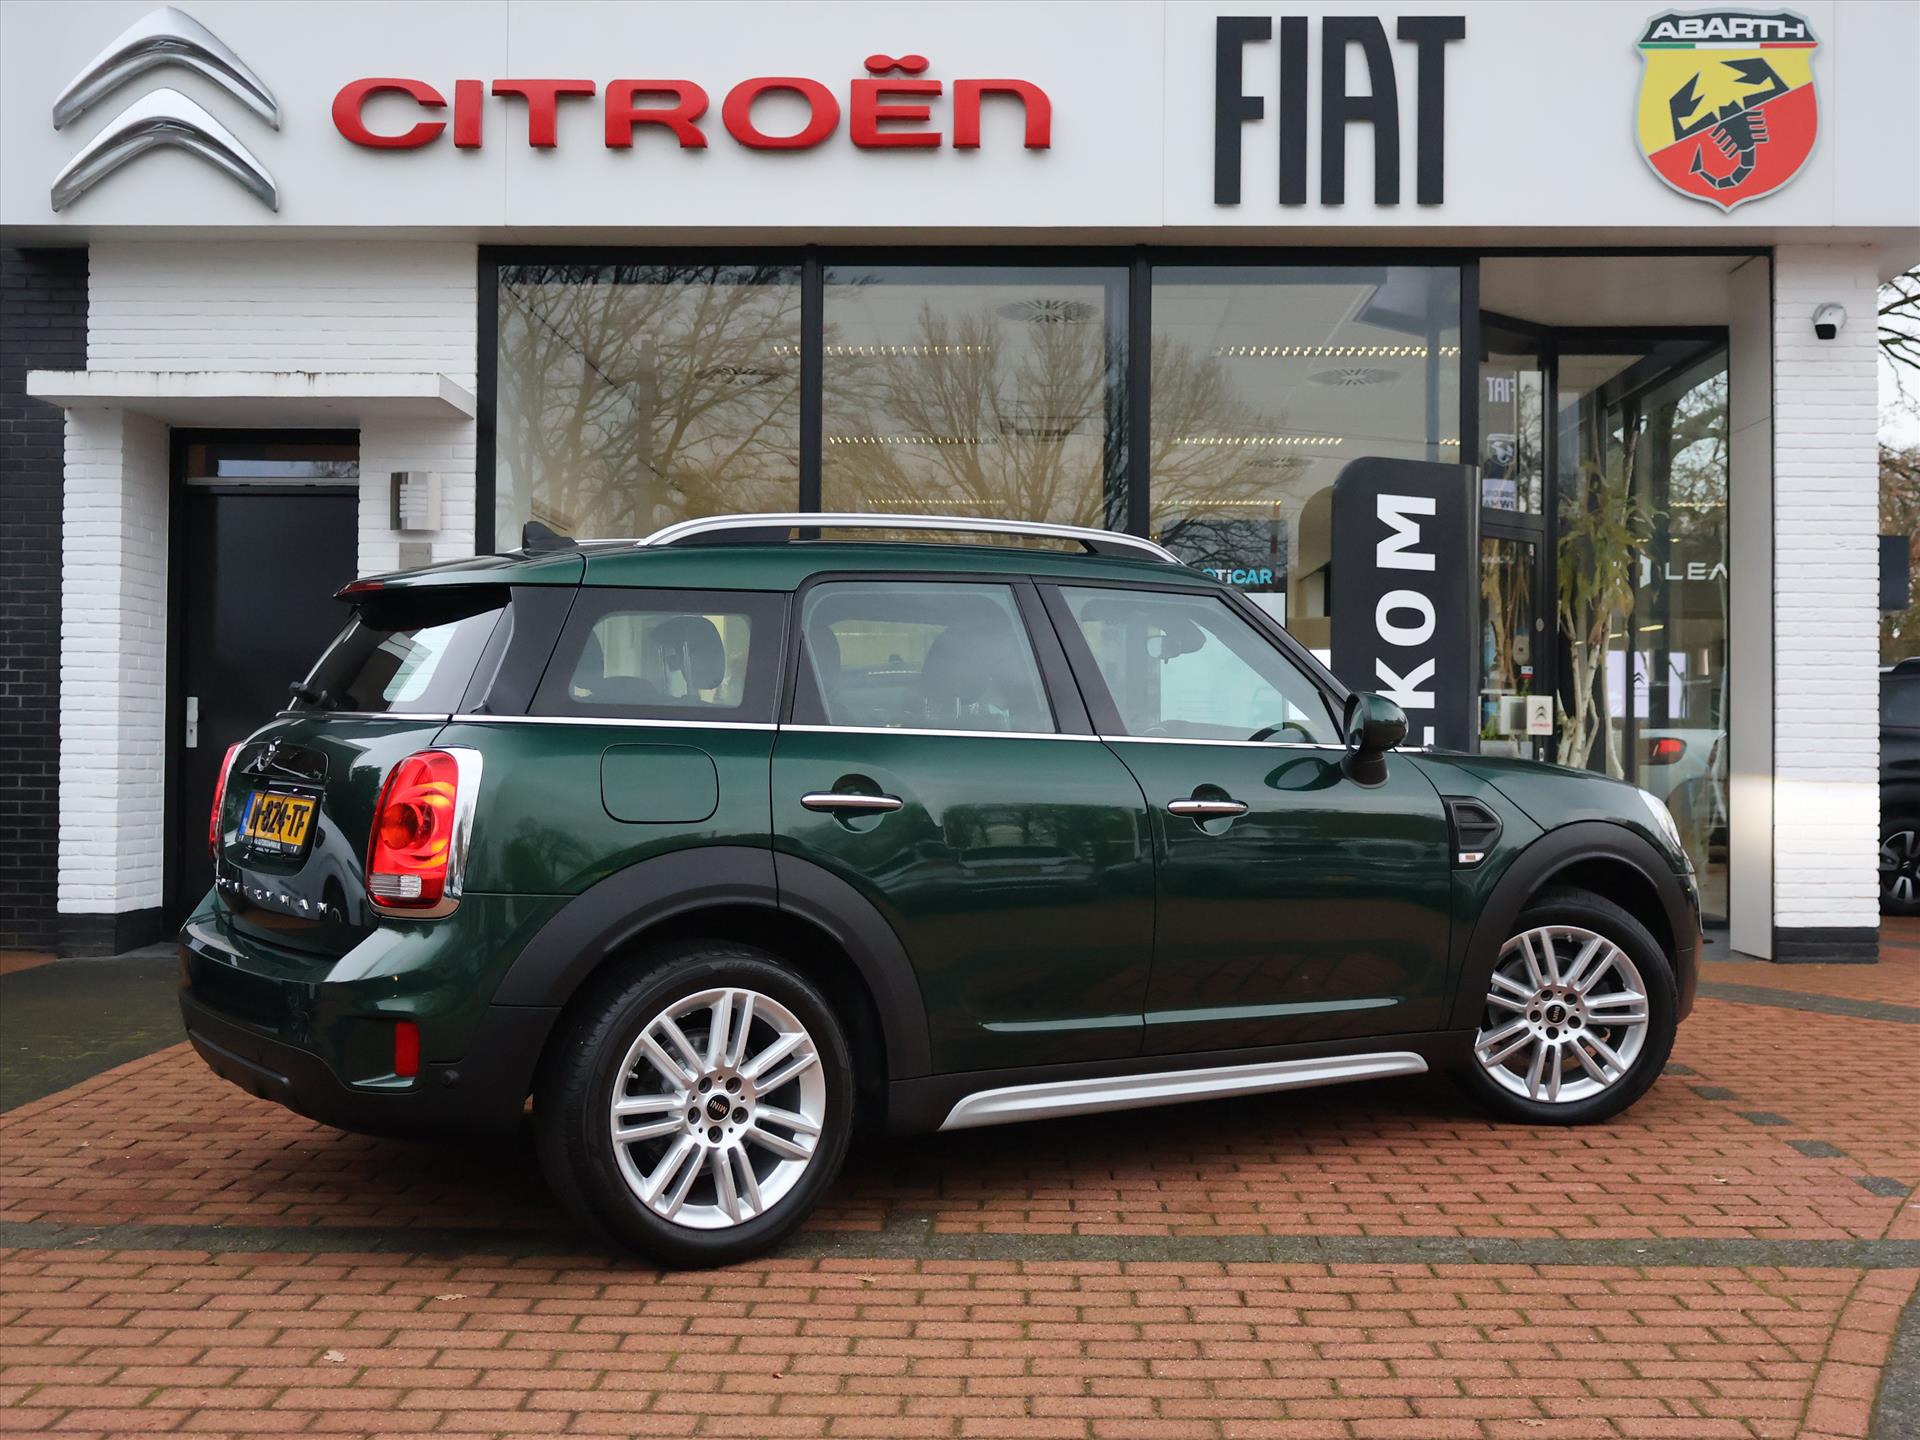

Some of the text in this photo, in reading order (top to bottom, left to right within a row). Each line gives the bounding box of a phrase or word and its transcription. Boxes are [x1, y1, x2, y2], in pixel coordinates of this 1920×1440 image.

[1651, 17, 1804, 39] ABARTH
[333, 54, 1052, 150] CITROËN
[1215, 16, 1465, 205] FIAT
[1375, 493, 1436, 747] KOM
